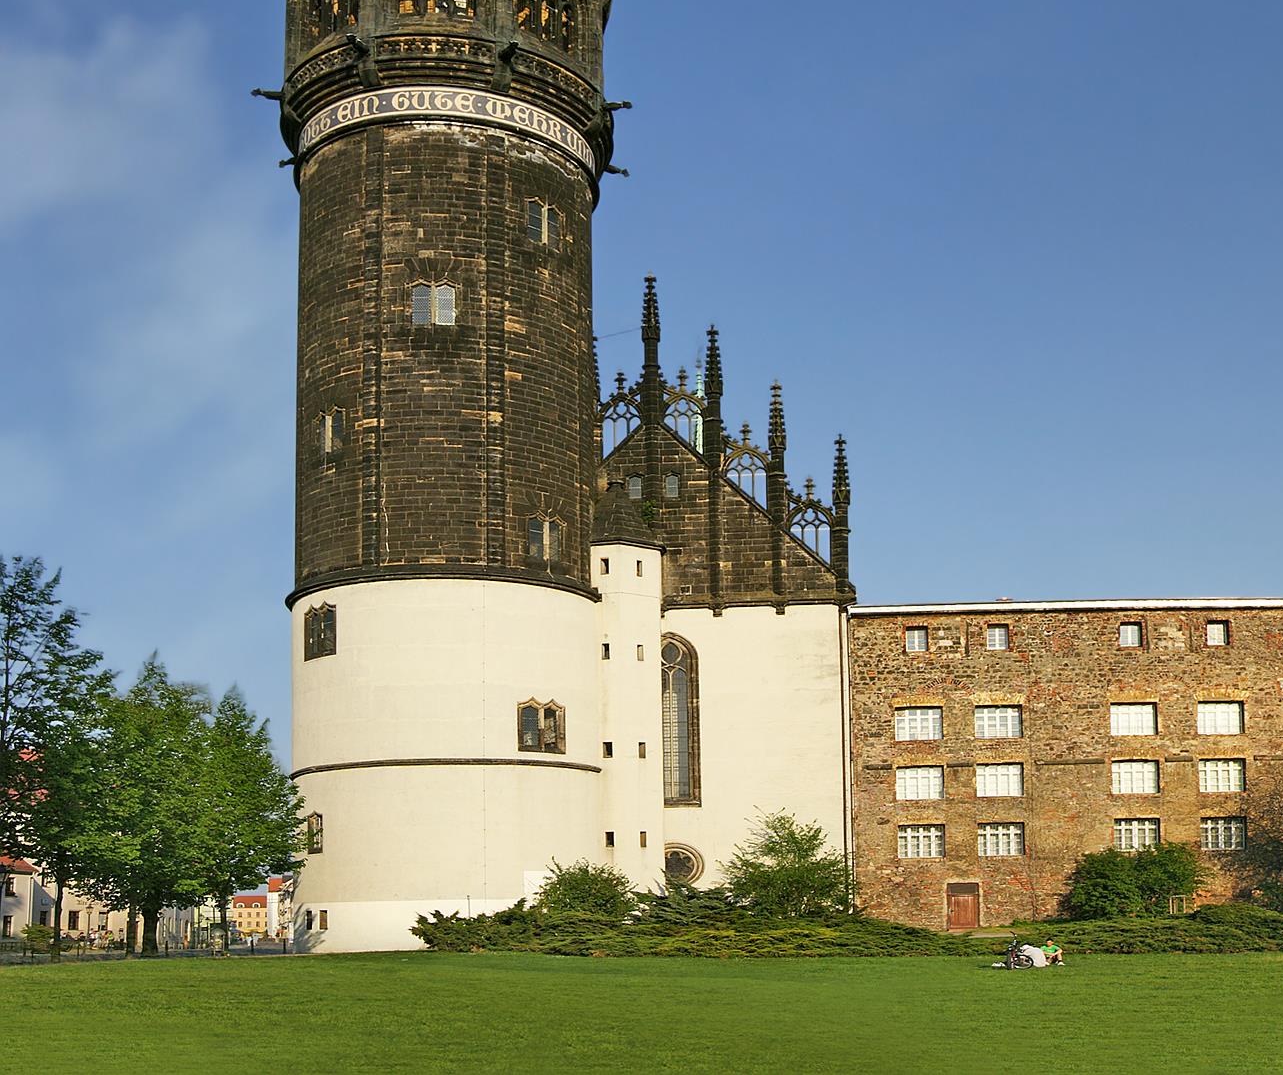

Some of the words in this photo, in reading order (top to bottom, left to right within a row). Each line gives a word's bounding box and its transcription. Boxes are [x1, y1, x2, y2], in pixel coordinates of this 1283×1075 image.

[299, 110, 331, 147] OTT
[337, 95, 379, 123] EIN
[391, 91, 476, 113] GUTE
[485, 97, 561, 141] WEHR
